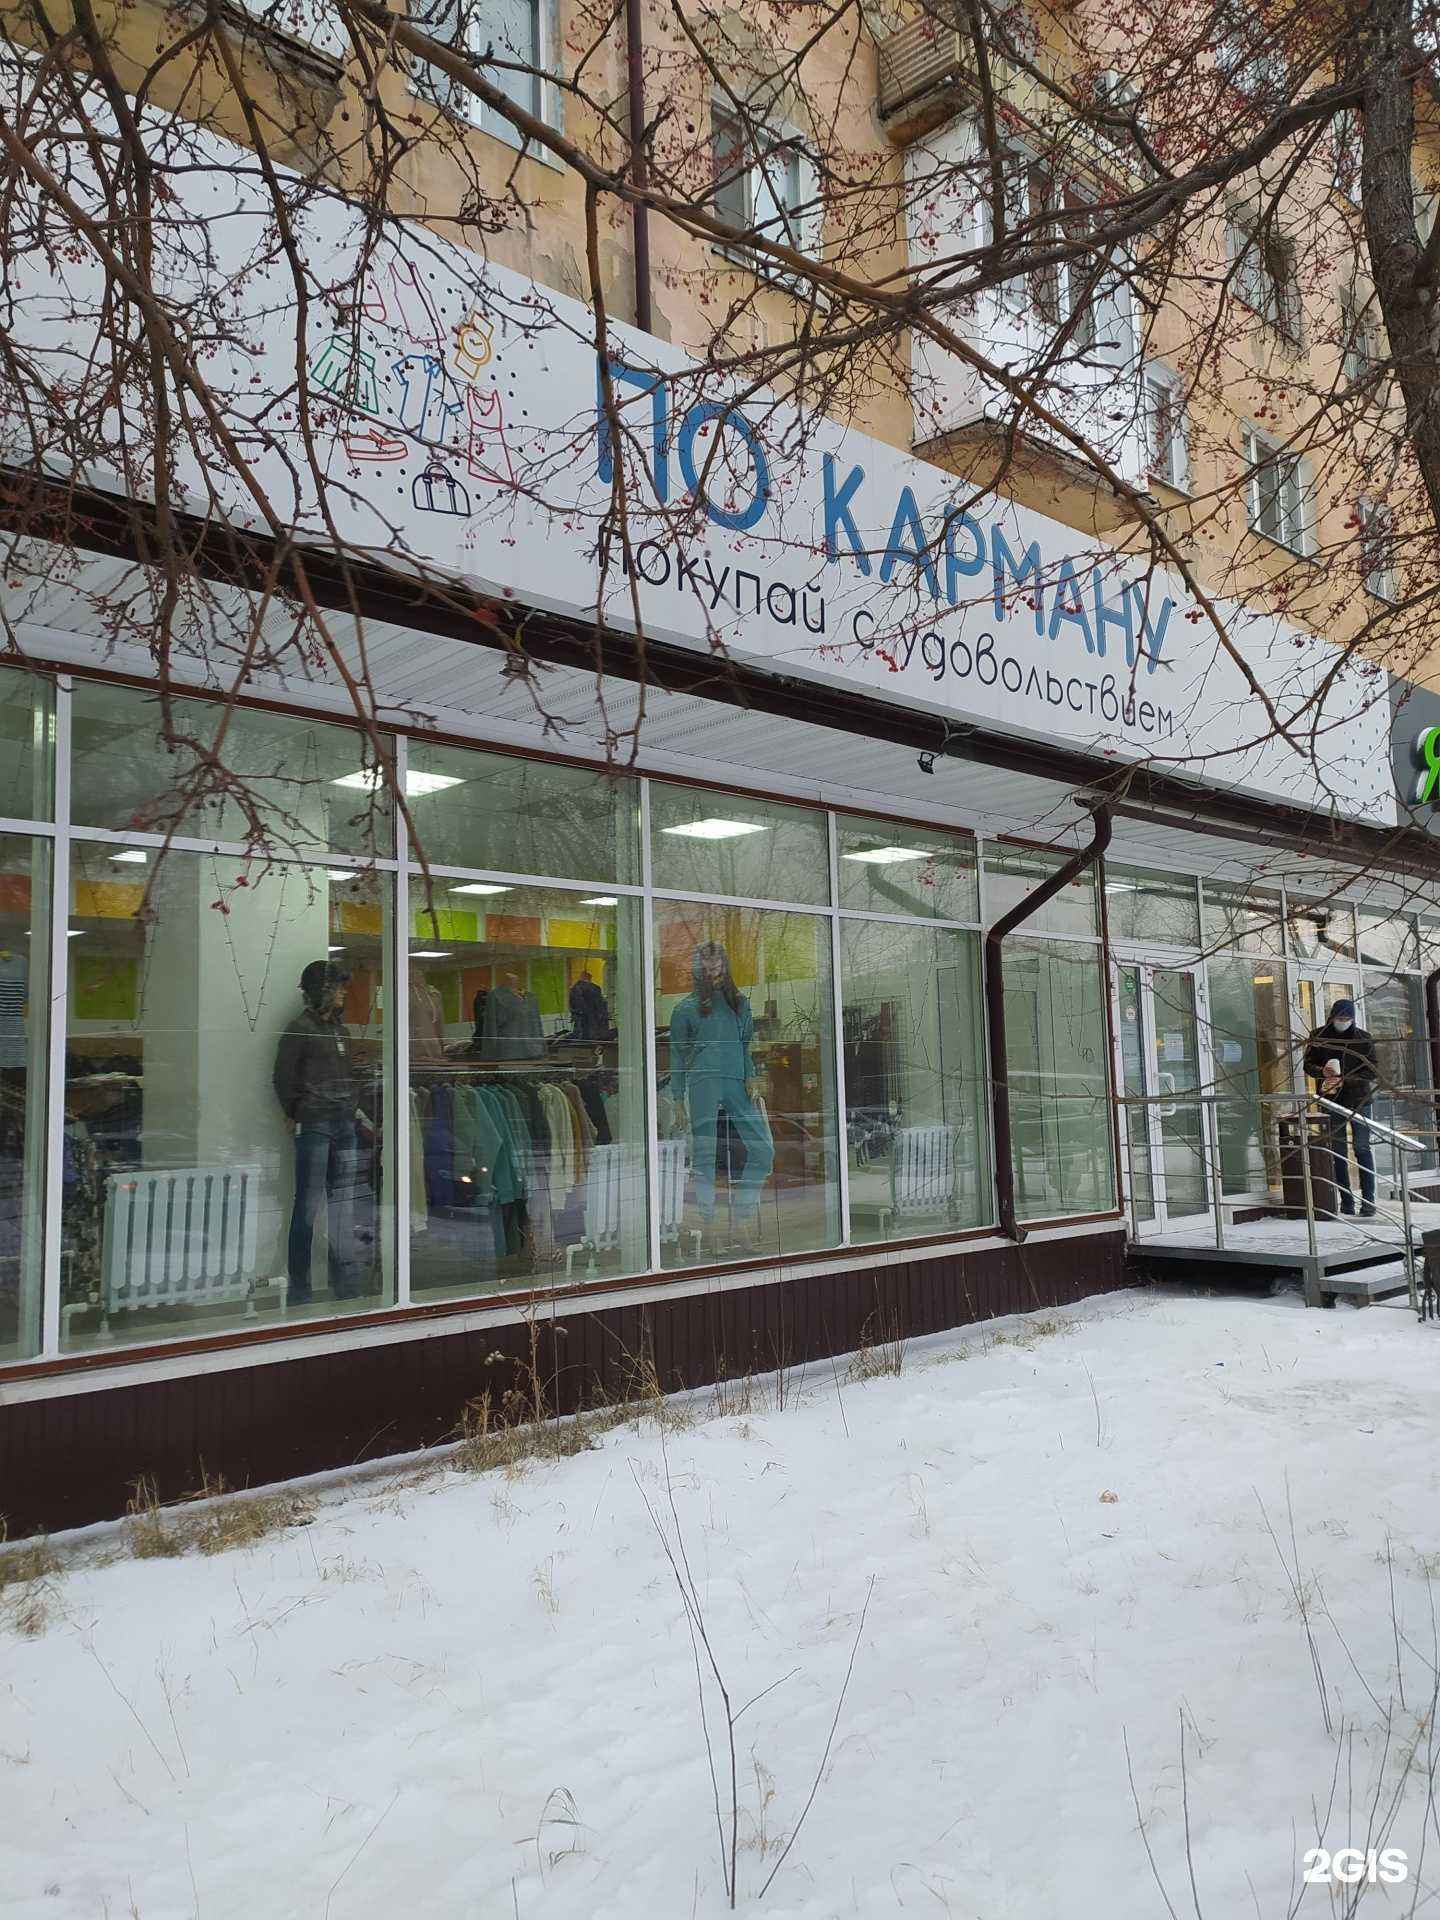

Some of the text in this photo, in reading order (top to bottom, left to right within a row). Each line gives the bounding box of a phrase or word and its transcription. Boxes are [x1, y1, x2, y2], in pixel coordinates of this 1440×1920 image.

[597, 353, 1173, 674] ПО КАРМАНУ
[853, 610, 875, 649] с
[899, 622, 1174, 738] удовольствием
